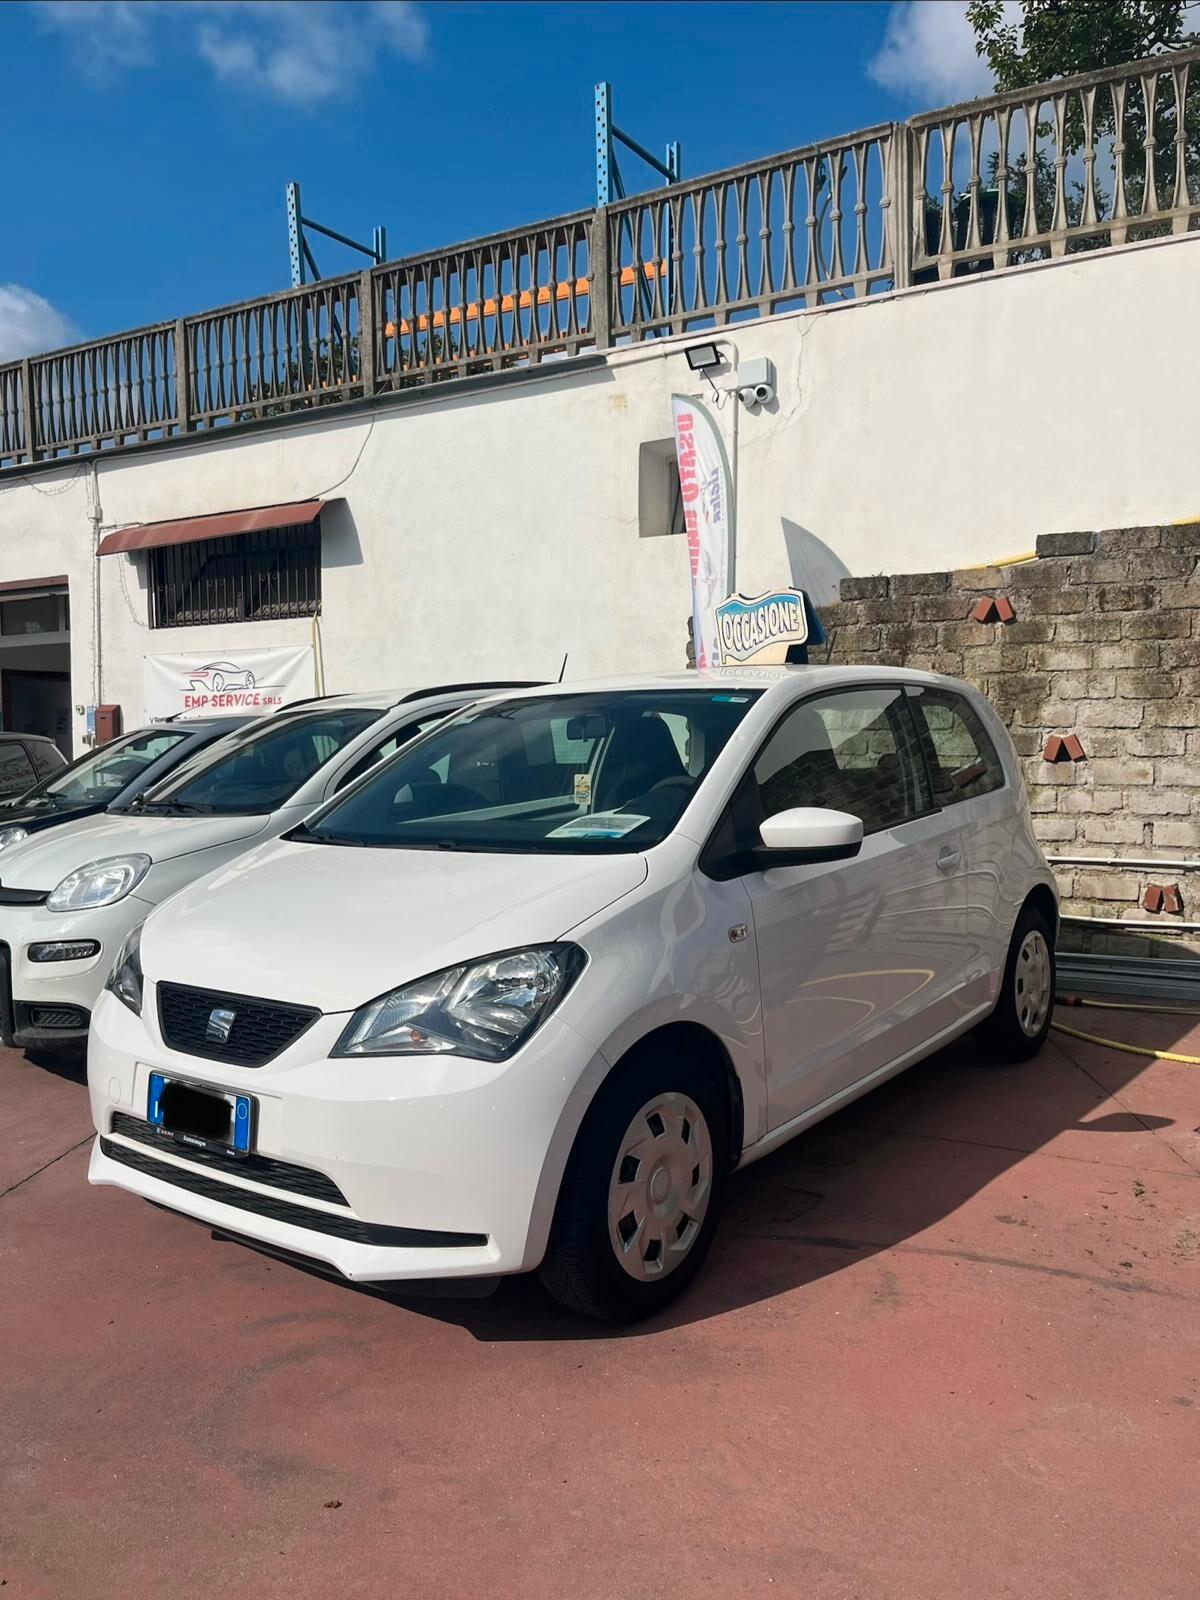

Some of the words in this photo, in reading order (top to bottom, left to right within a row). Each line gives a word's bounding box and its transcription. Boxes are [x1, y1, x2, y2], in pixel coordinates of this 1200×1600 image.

[722, 601, 800, 652] OCCASIONE
[184, 694, 209, 708] EMP
[211, 692, 261, 707] SERVICE
[262, 696, 282, 705] SRLS
